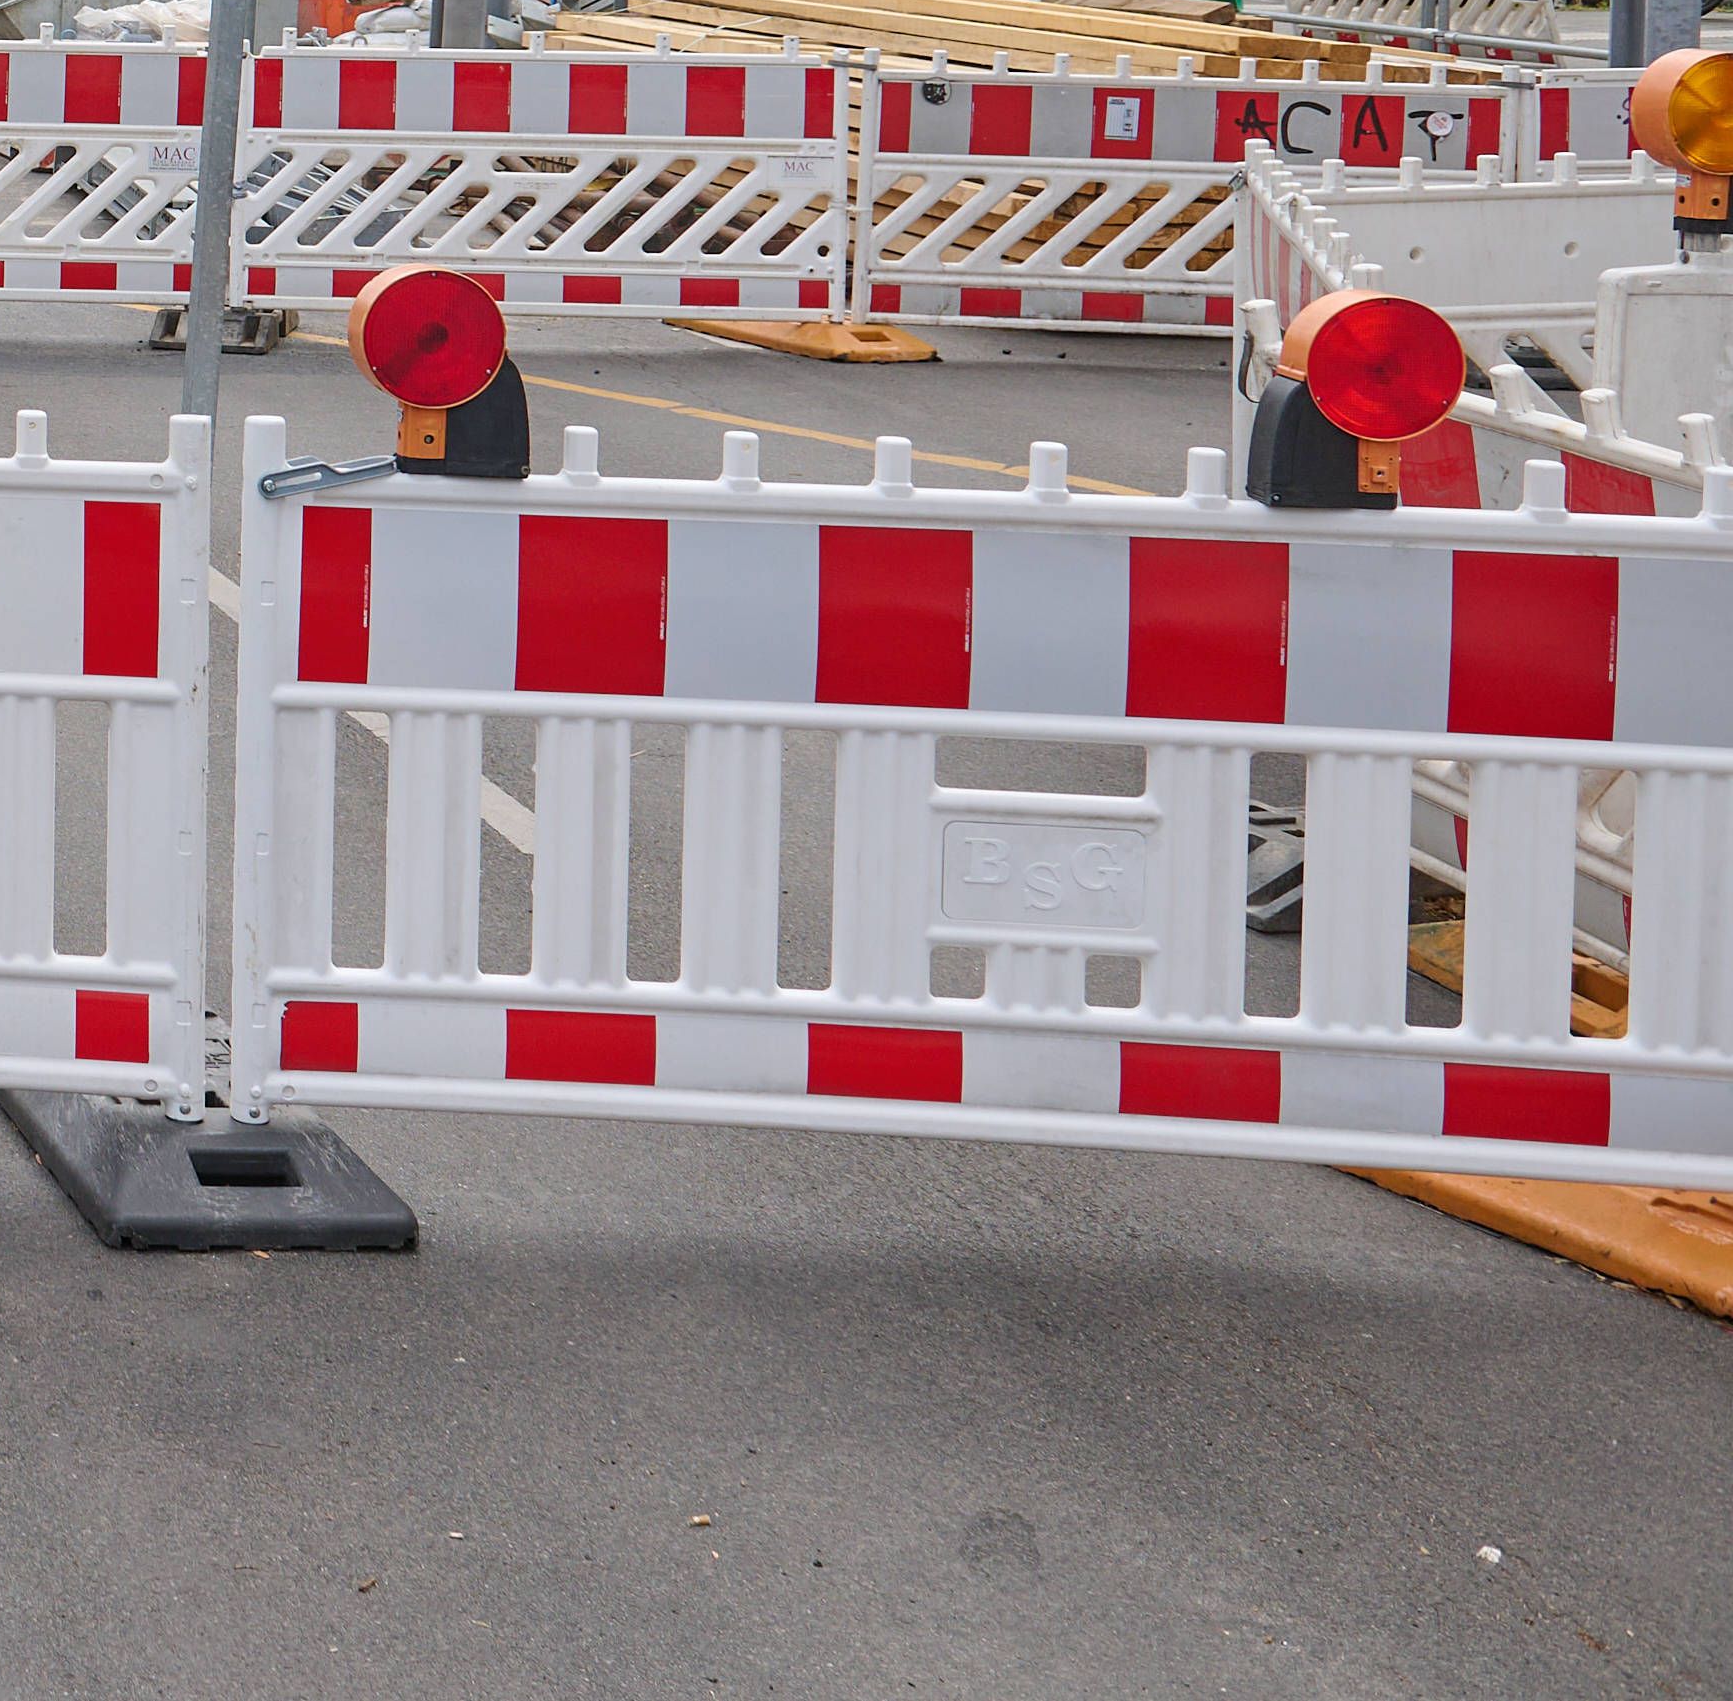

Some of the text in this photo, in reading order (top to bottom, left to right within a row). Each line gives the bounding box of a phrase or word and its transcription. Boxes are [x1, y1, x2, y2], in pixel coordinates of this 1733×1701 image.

[153, 146, 196, 161] MAC
[785, 162, 814, 172] MAC
[962, 836, 1124, 911] BSG
